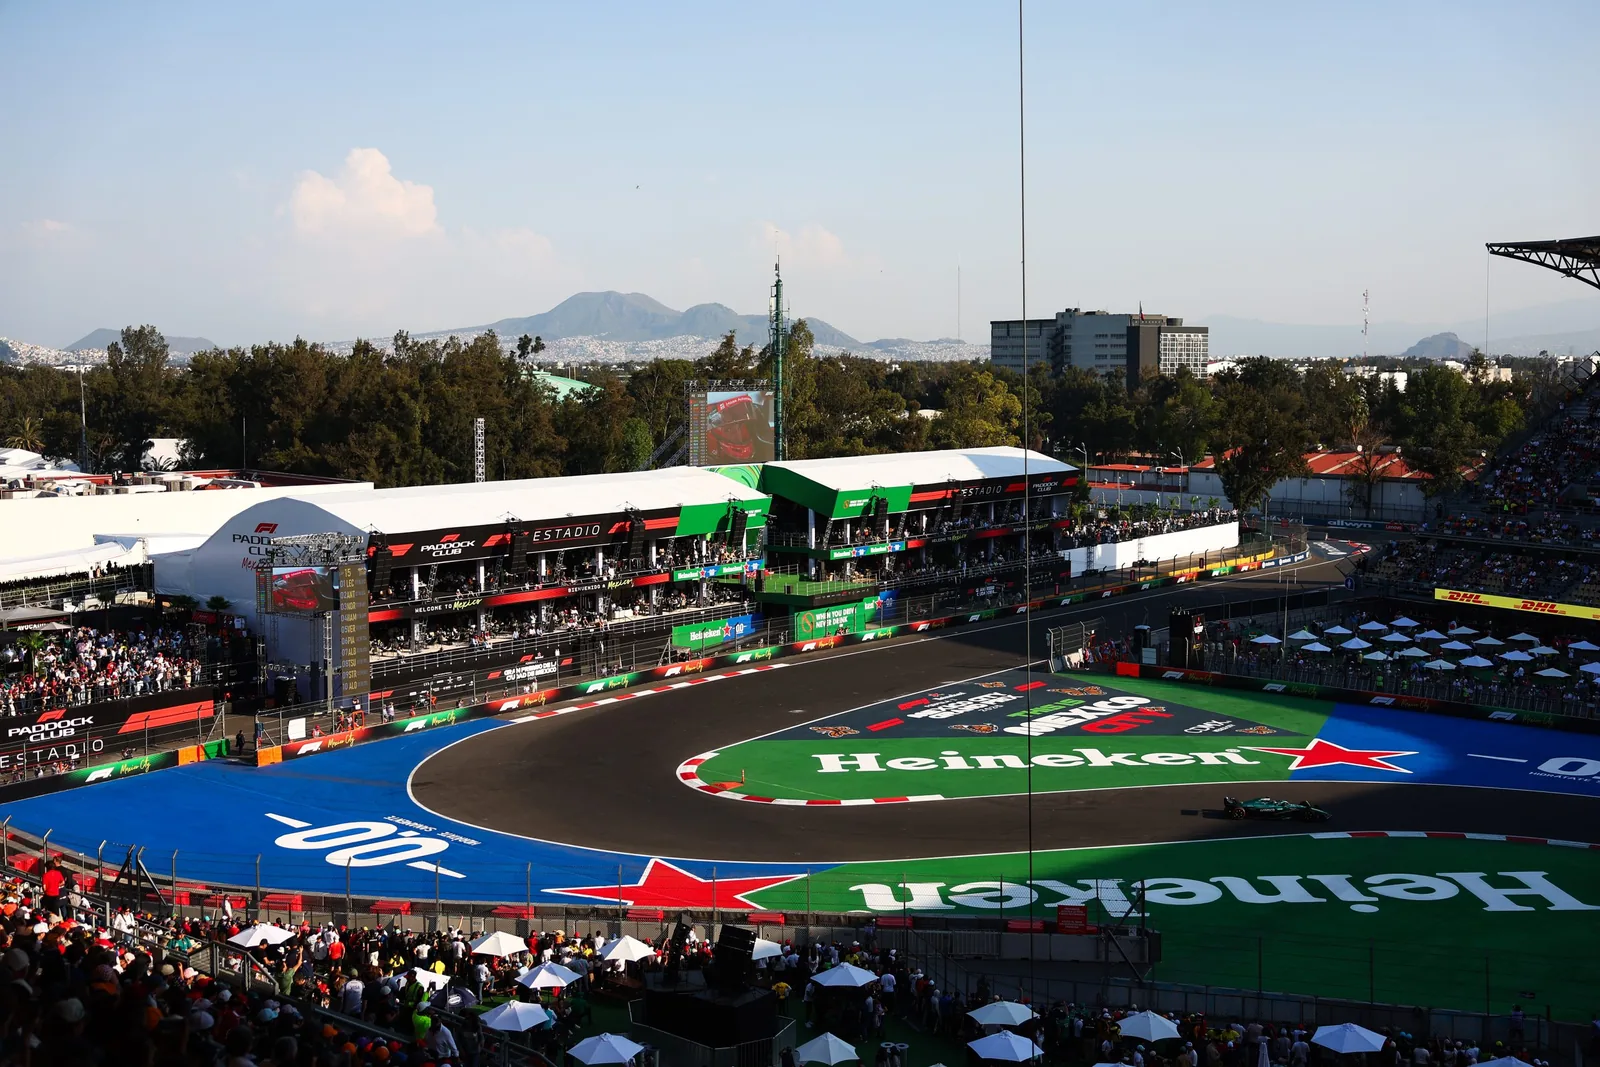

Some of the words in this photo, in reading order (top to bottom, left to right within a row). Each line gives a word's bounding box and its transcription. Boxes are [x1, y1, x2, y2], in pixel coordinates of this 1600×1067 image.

[961, 485, 1002, 497] ESTADIO
[1328, 520, 1372, 528] allwyn
[533, 524, 600, 542] ESTADIO
[232, 534, 276, 546] PADD
[421, 540, 475, 552] PADDOCK
[432, 548, 461, 557] CLUB
[344, 569, 351, 577] 15
[568, 585, 600, 593] BIENVENIDO
[1448, 591, 1483, 604] DHL
[415, 605, 442, 613] WELCOME
[1521, 601, 1558, 613] DHL
[816, 612, 831, 620] WHEN
[833, 616, 848, 625] DRINK
[347, 625, 356, 633] VER
[349, 682, 357, 690] ALO
[432, 716, 445, 726] Mexico
[446, 711, 456, 725] City
[1003, 696, 1151, 736] MEXICO
[1081, 708, 1175, 733] CITY
[8, 716, 93, 737] PADDOCK
[29, 729, 75, 742] CLUB
[328, 737, 344, 748] Mexico
[345, 733, 355, 746] City
[0, 739, 104, 769] ESTADIO
[811, 748, 1261, 772] Heineken
[120, 763, 139, 774] Mexico
[140, 757, 151, 773] City
[848, 871, 1600, 917] Heineken
